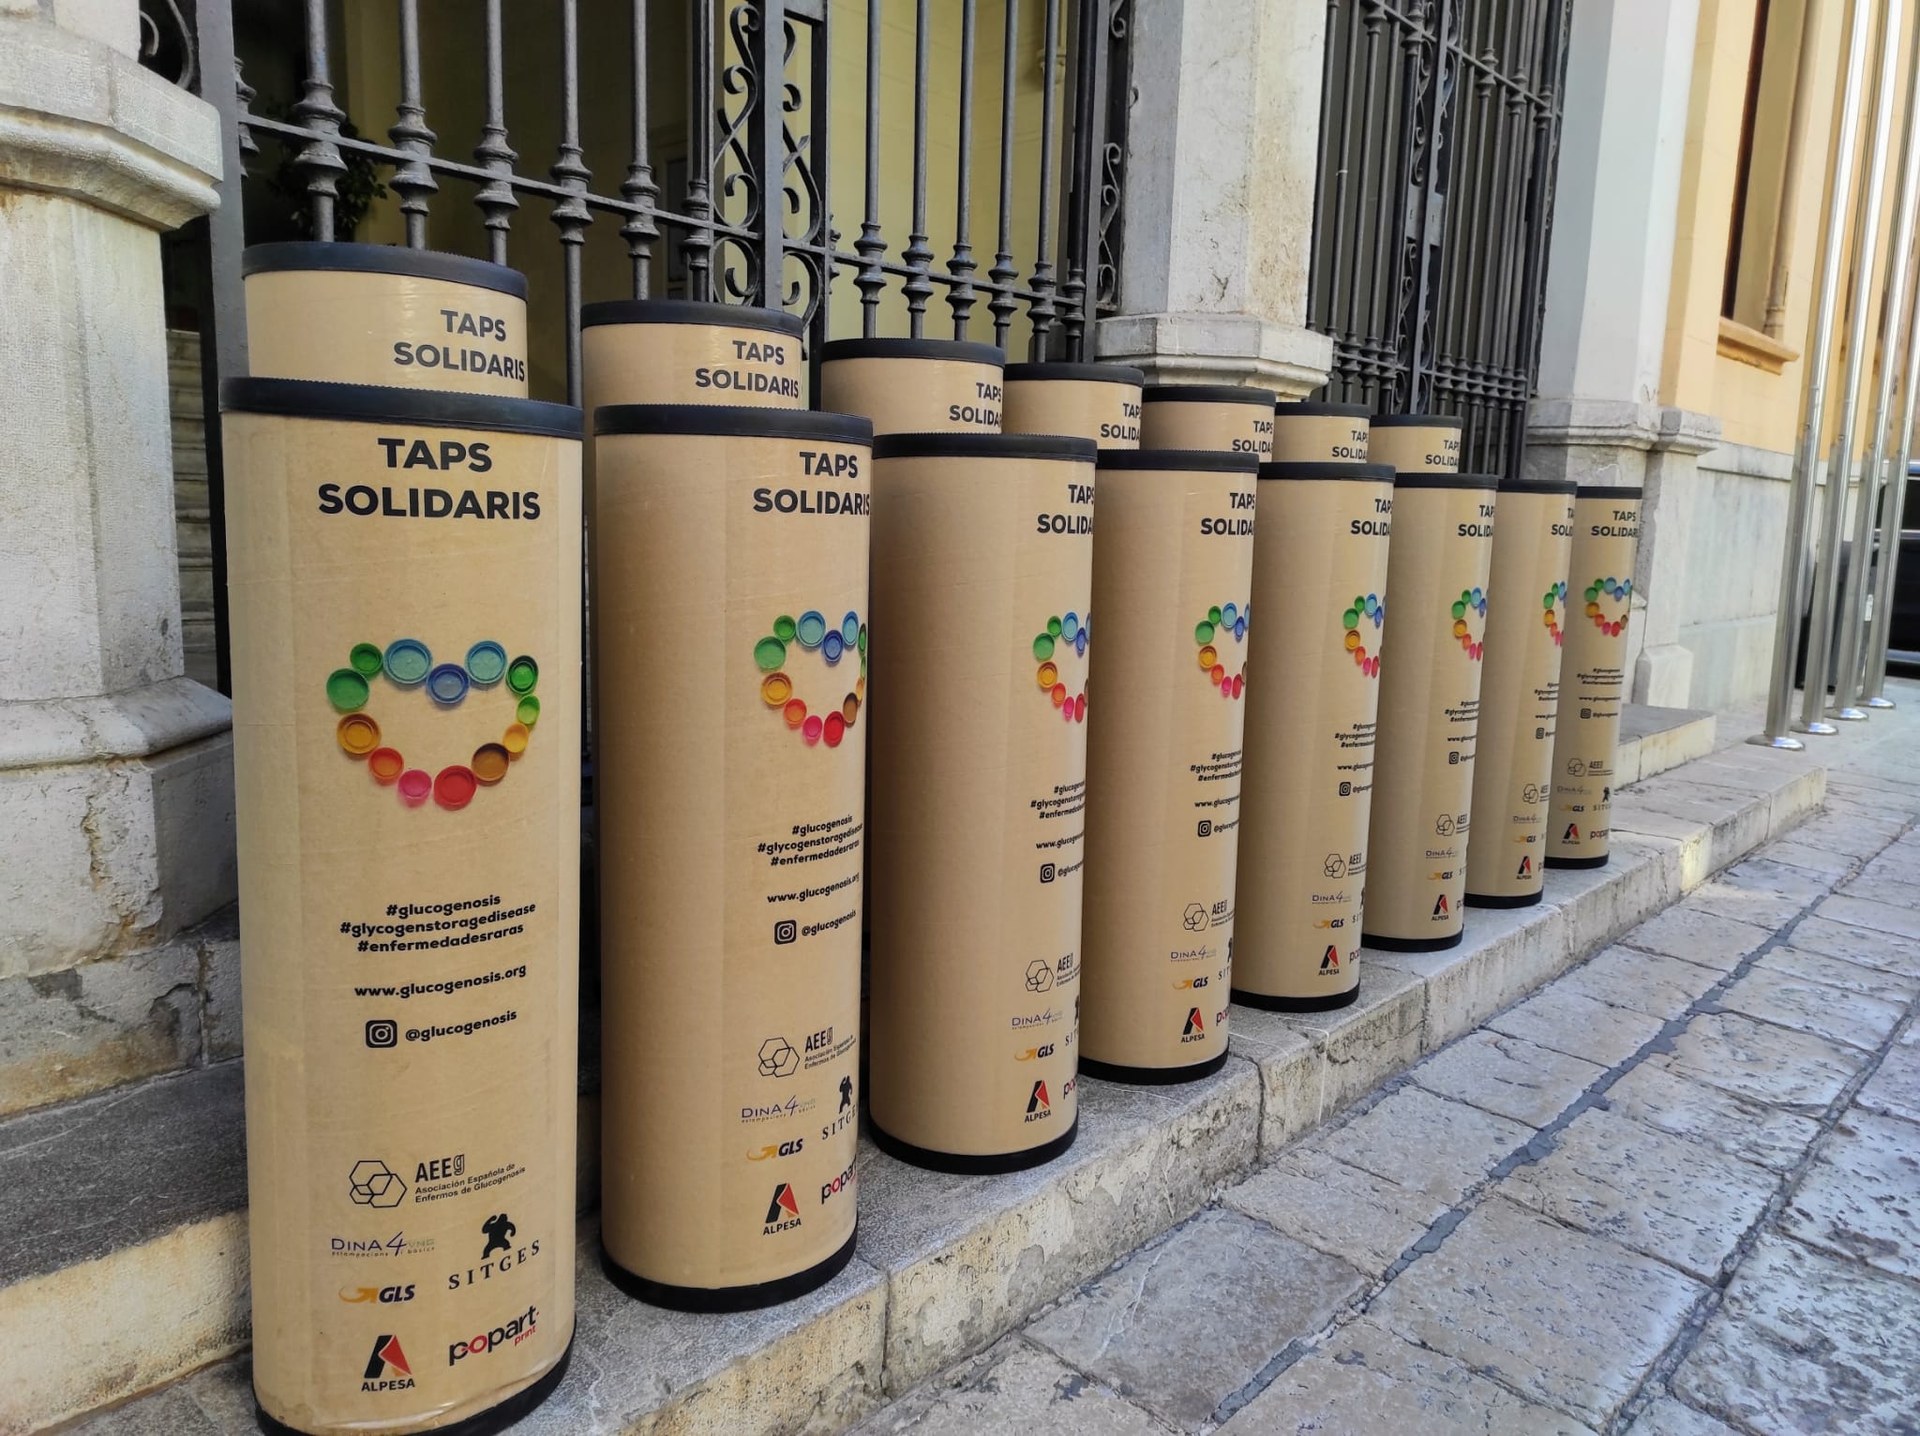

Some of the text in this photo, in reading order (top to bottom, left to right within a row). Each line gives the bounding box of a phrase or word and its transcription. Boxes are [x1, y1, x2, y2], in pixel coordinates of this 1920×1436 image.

[440, 309, 507, 342] TAPS
[393, 341, 526, 383] SOLIDARIS
[732, 340, 785, 366] TAPS
[695, 368, 799, 399] SOLIDARIS
[949, 404, 1002, 428] SOLIDA
[377, 437, 493, 473] TAPS
[1231, 439, 1273, 454] SOLIDA
[799, 451, 859, 479] TAPS
[318, 483, 541, 520] SOLIDARIS
[752, 487, 871, 517] SOLIDARIS
[1612, 510, 1637, 522] TAPS
[791, 813, 854, 838] #glucogenosis
[386, 894, 502, 920] #glucogenosis
[340, 903, 536, 938] #glycogenstoragedisease
[1330, 918, 1345, 929] GLS
[357, 923, 524, 953] #enfermedadesraras
[354, 965, 527, 999] www.glucogenosis.org
[1192, 975, 1209, 989] GLS
[405, 1010, 517, 1042] @glucogenosis
[1180, 1032, 1205, 1044] ALPESA
[1037, 1042, 1055, 1059] GLS
[1024, 1109, 1052, 1124] ALPESA
[778, 1137, 804, 1157] GLS
[414, 1163, 516, 1195] Asociación Española de
[415, 1166, 526, 1203] Enfermos de Glucogenosis
[762, 1218, 802, 1236] ALPESA
[447, 1239, 541, 1290] SITGES
[378, 1284, 416, 1304] GLS
[448, 1305, 538, 1367] popart
[514, 1325, 537, 1347] print
[361, 1377, 416, 1393] ALPESA
